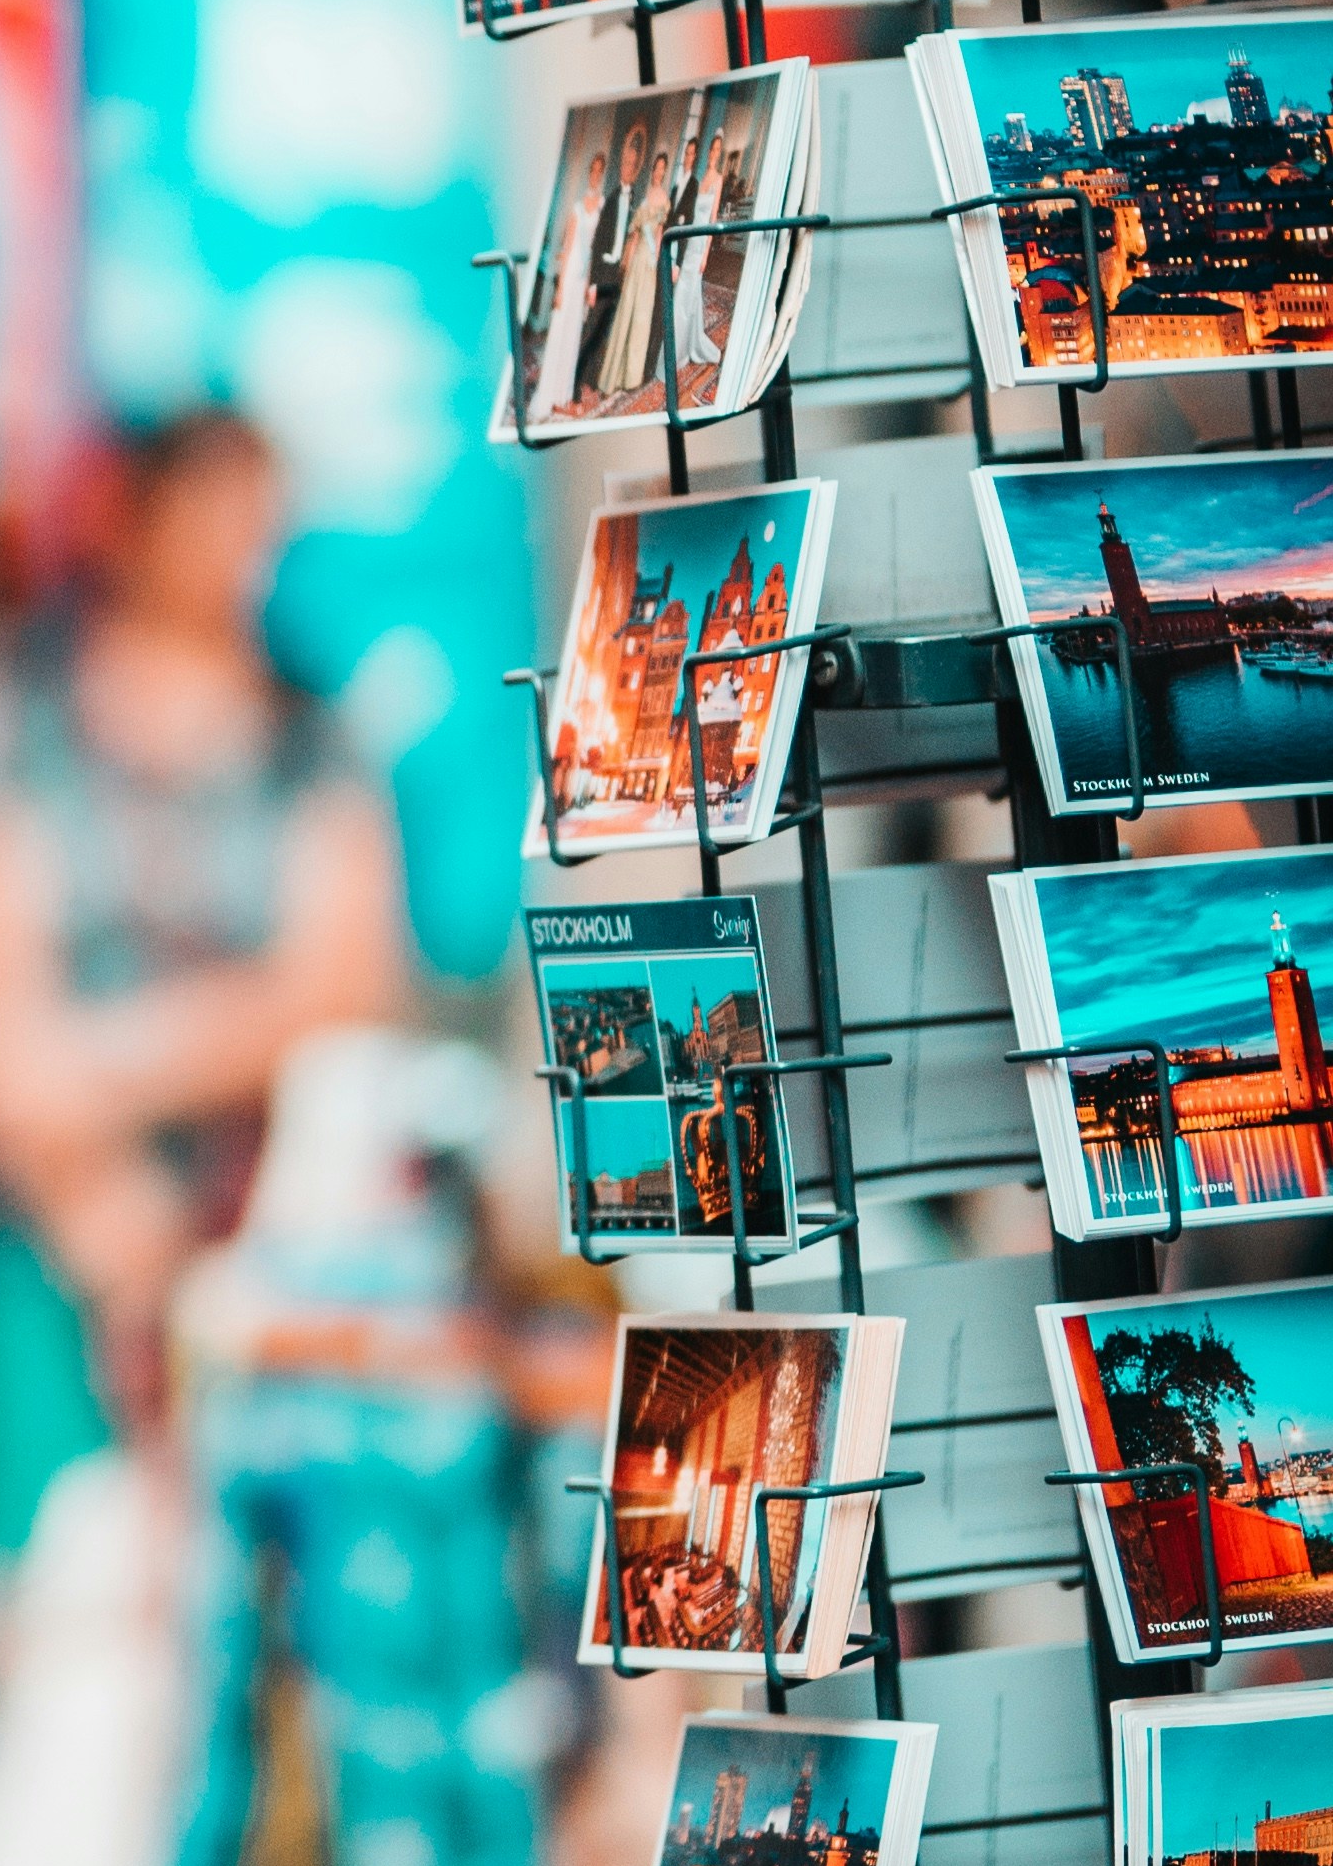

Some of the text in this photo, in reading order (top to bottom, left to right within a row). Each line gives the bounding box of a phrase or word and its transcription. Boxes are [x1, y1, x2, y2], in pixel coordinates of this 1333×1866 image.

[1073, 771, 1210, 792] STOCKHOM SWEDEN
[532, 910, 753, 945] STOCKHOLM Sverige
[1184, 1182, 1233, 1197] SWEDEN
[1224, 1611, 1273, 1626] SWEDEN
